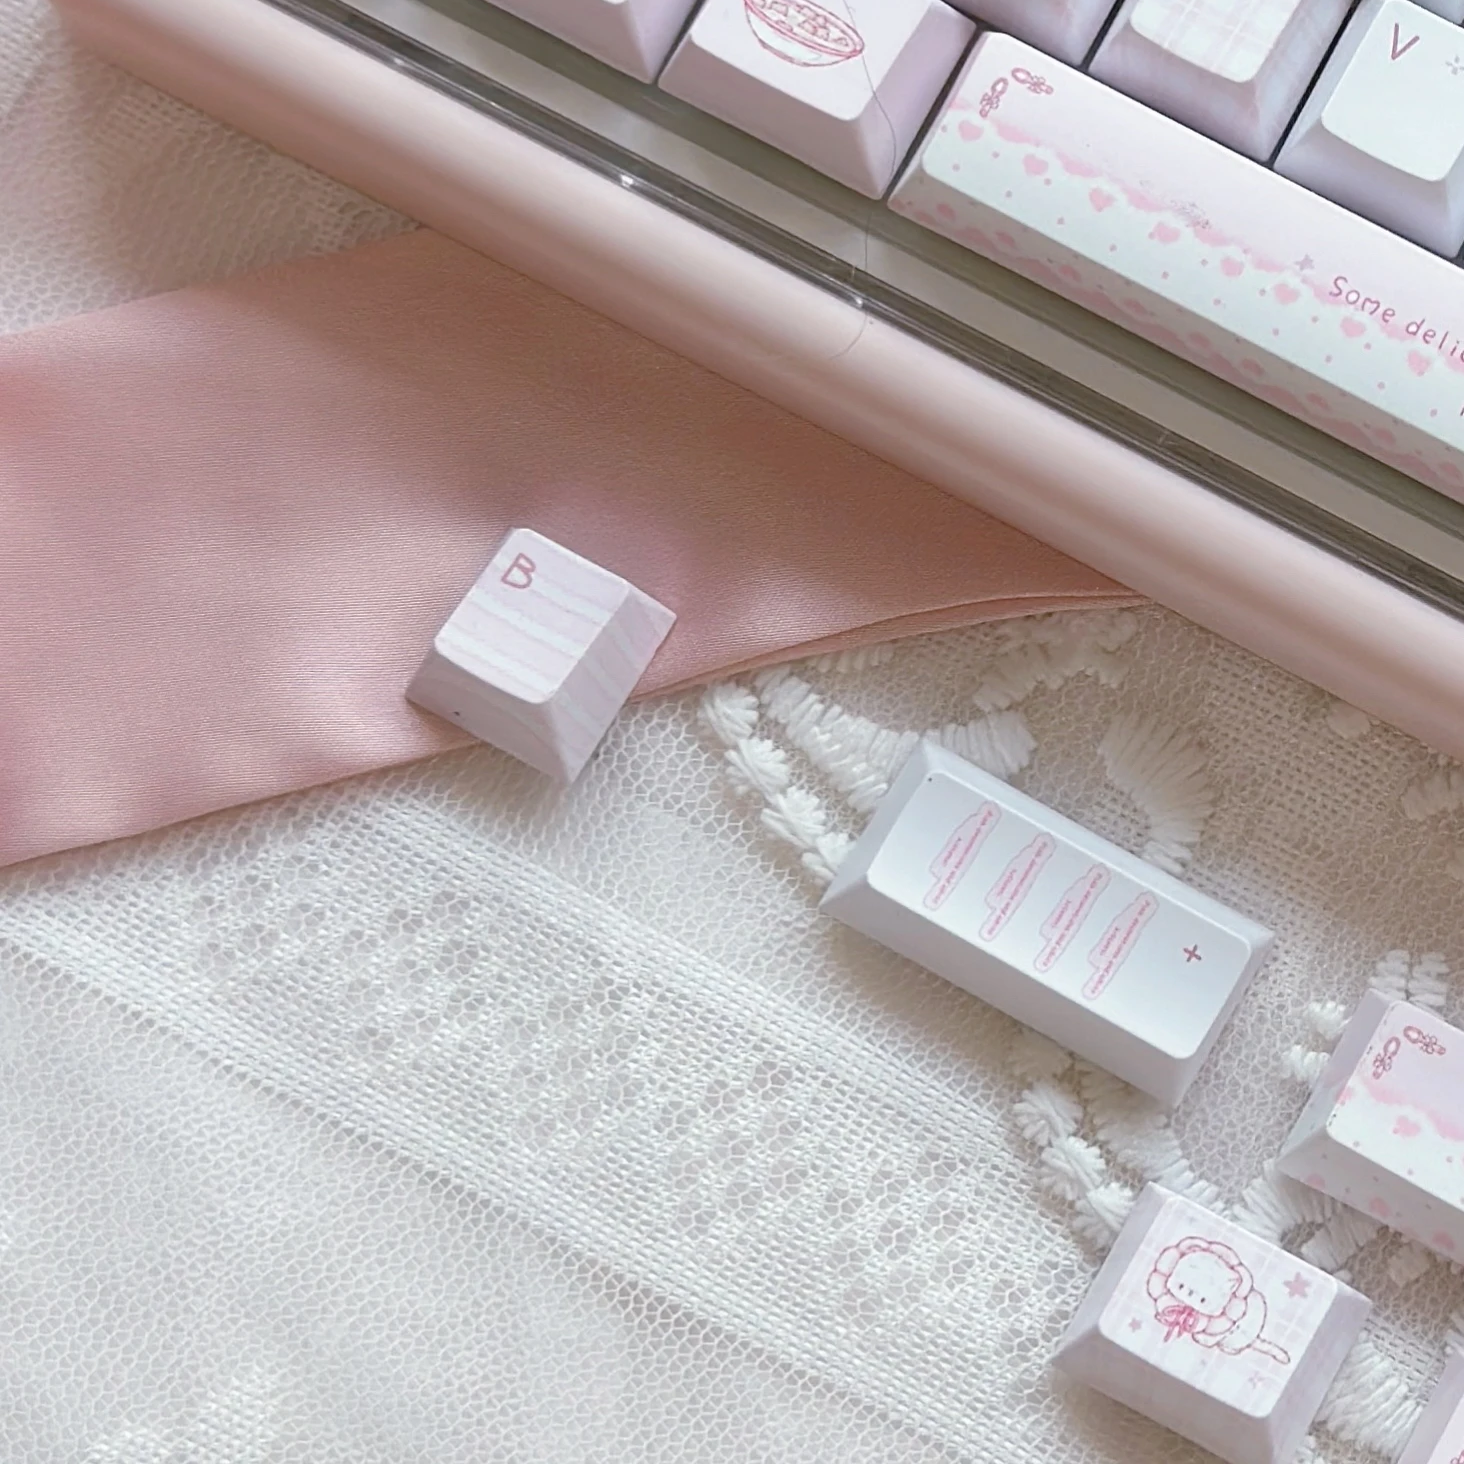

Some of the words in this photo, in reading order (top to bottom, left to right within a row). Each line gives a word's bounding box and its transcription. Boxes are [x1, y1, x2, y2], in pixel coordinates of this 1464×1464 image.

[1390, 23, 1419, 61] V
[1329, 276, 1395, 323] Some
[501, 553, 535, 590] B
